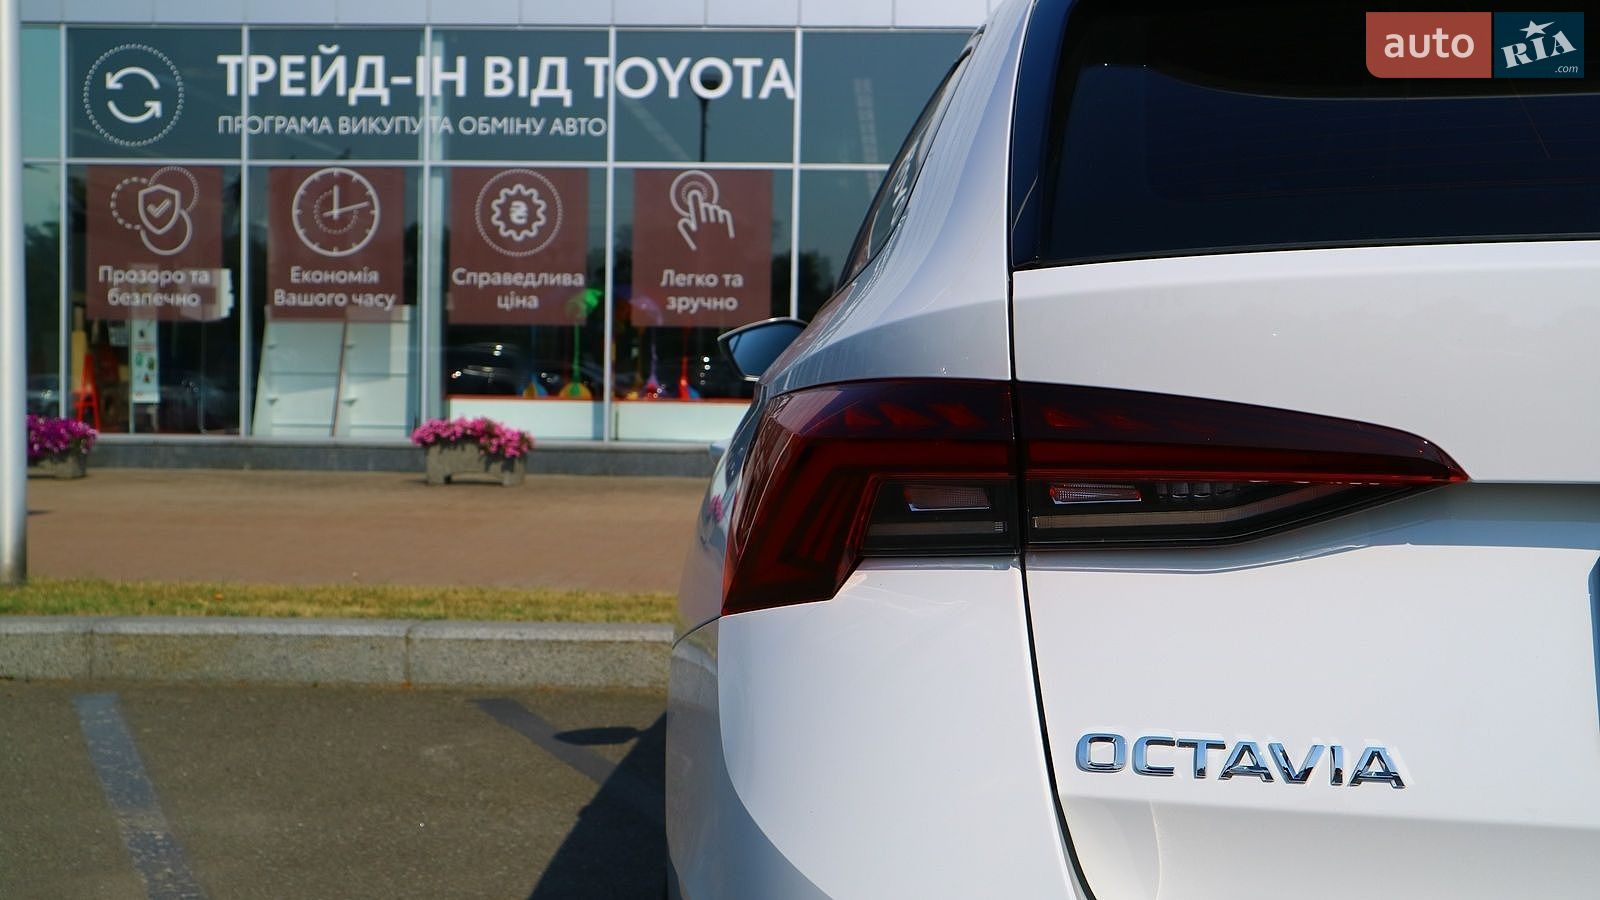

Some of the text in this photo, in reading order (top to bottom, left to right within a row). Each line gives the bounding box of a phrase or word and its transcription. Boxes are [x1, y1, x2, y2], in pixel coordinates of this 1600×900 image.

[217, 44, 796, 107] ТРЕЙД-ІН ВІД TOYOTA
[218, 115, 333, 135] ПРОГРАМА
[338, 116, 424, 135] ВИКУПУ
[458, 116, 547, 136] ОБМІНУ
[549, 117, 608, 136] АВТО
[98, 265, 211, 288] Прозоро та
[290, 265, 380, 284] Економія
[452, 267, 585, 289] Справедлива
[660, 269, 744, 288] Легко та
[107, 287, 202, 307] безпечно
[274, 287, 397, 312] Вашого часу
[496, 291, 540, 311] ціна
[666, 295, 739, 315] зручно
[1075, 731, 1406, 790] OCTAVIA
